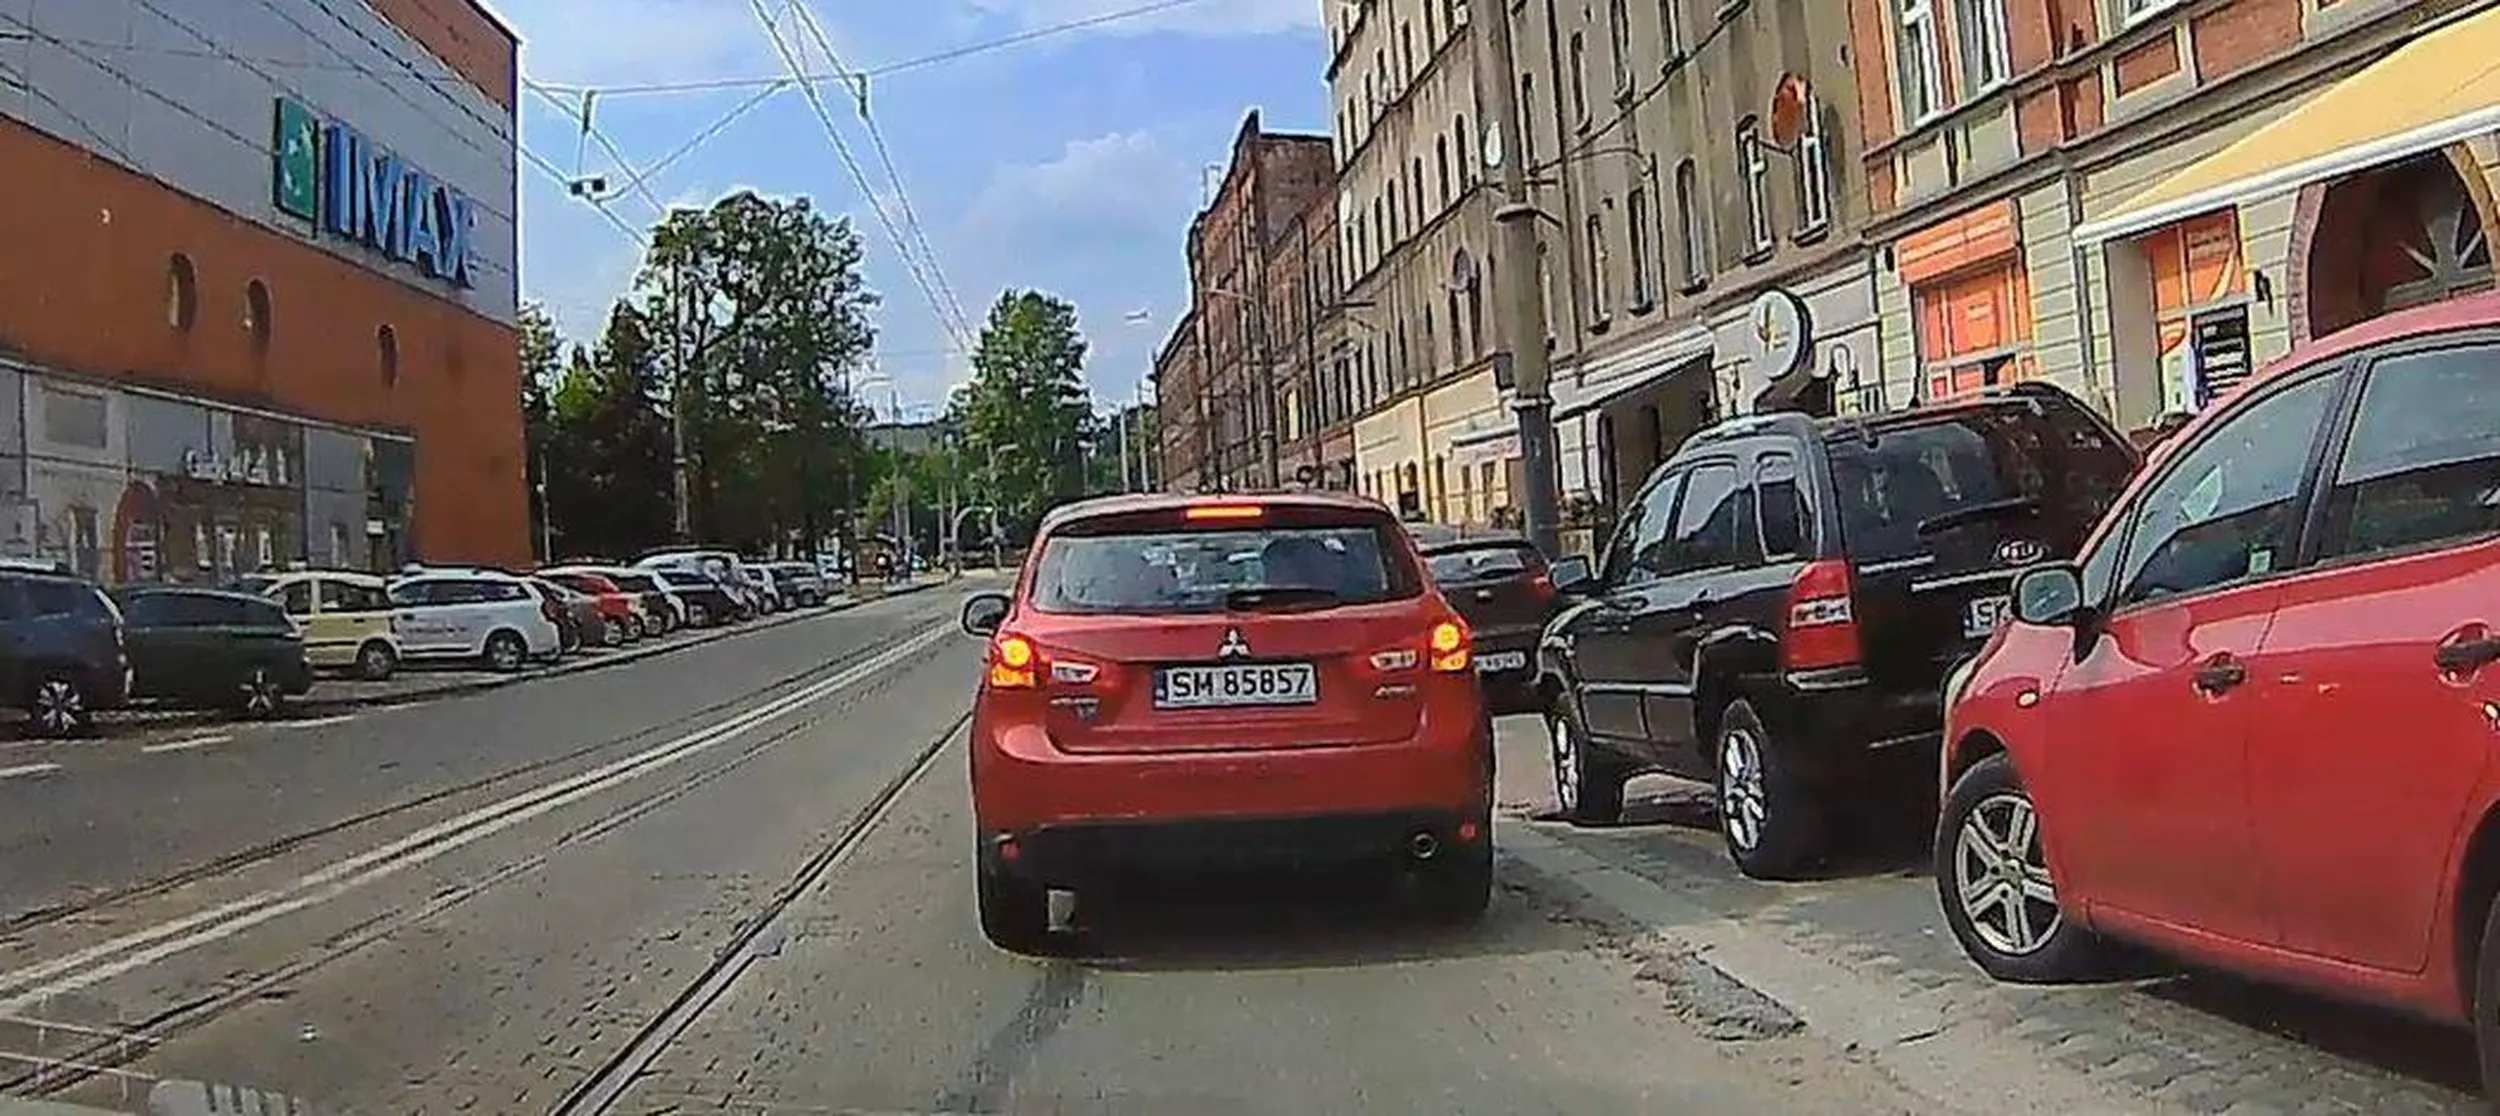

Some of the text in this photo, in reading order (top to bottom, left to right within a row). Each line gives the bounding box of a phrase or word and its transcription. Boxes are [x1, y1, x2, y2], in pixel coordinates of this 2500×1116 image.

[326, 122, 475, 290] IMAX
[1173, 668, 1310, 697] SM 85857
